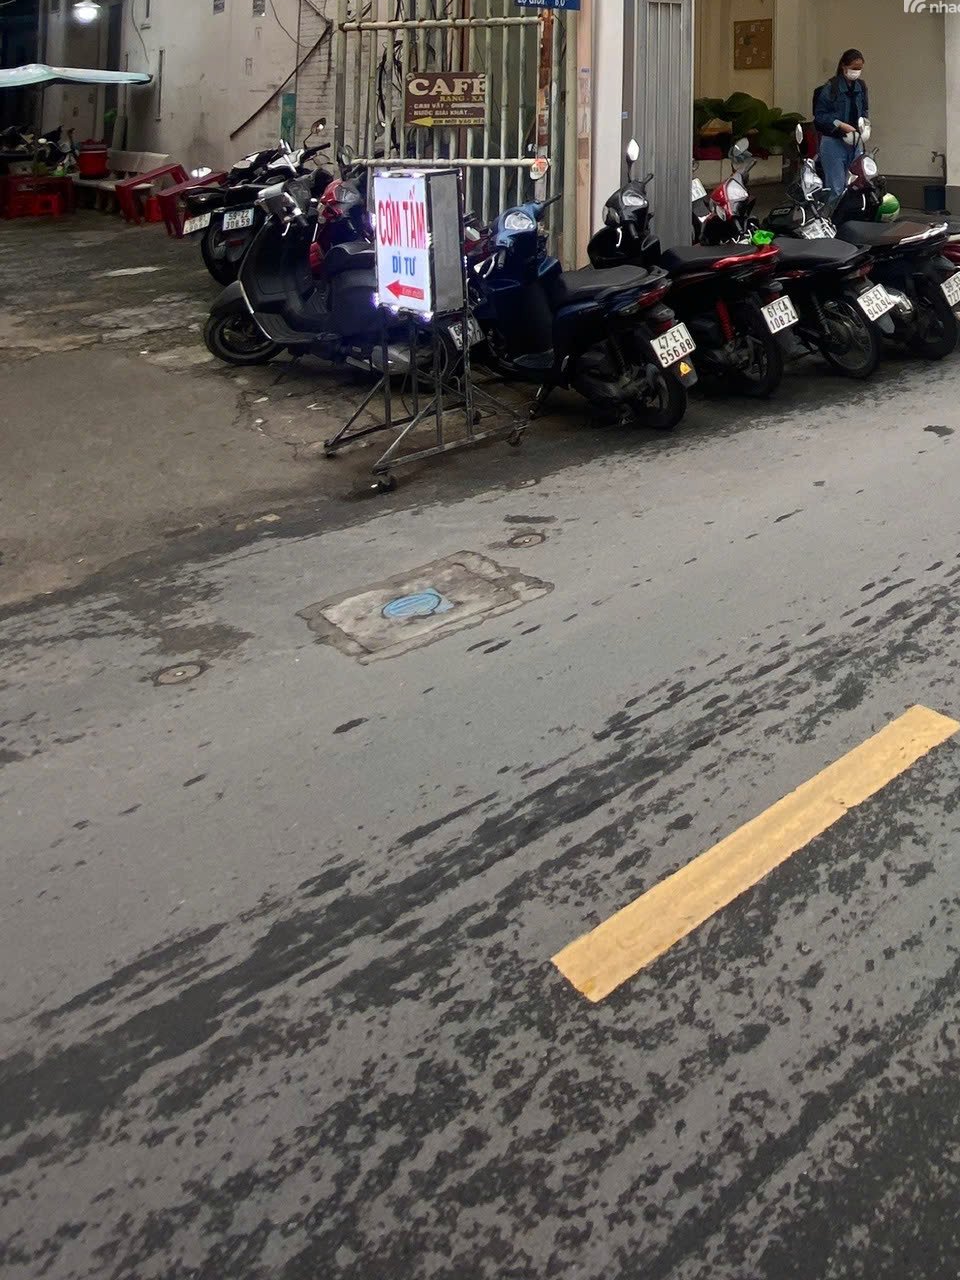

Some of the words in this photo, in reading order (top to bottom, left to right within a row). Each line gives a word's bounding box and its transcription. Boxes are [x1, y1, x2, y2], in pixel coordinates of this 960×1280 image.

[408, 73, 486, 96] CAFÉ
[657, 329, 684, 350] 47-E1
[660, 338, 693, 365] 556.88
